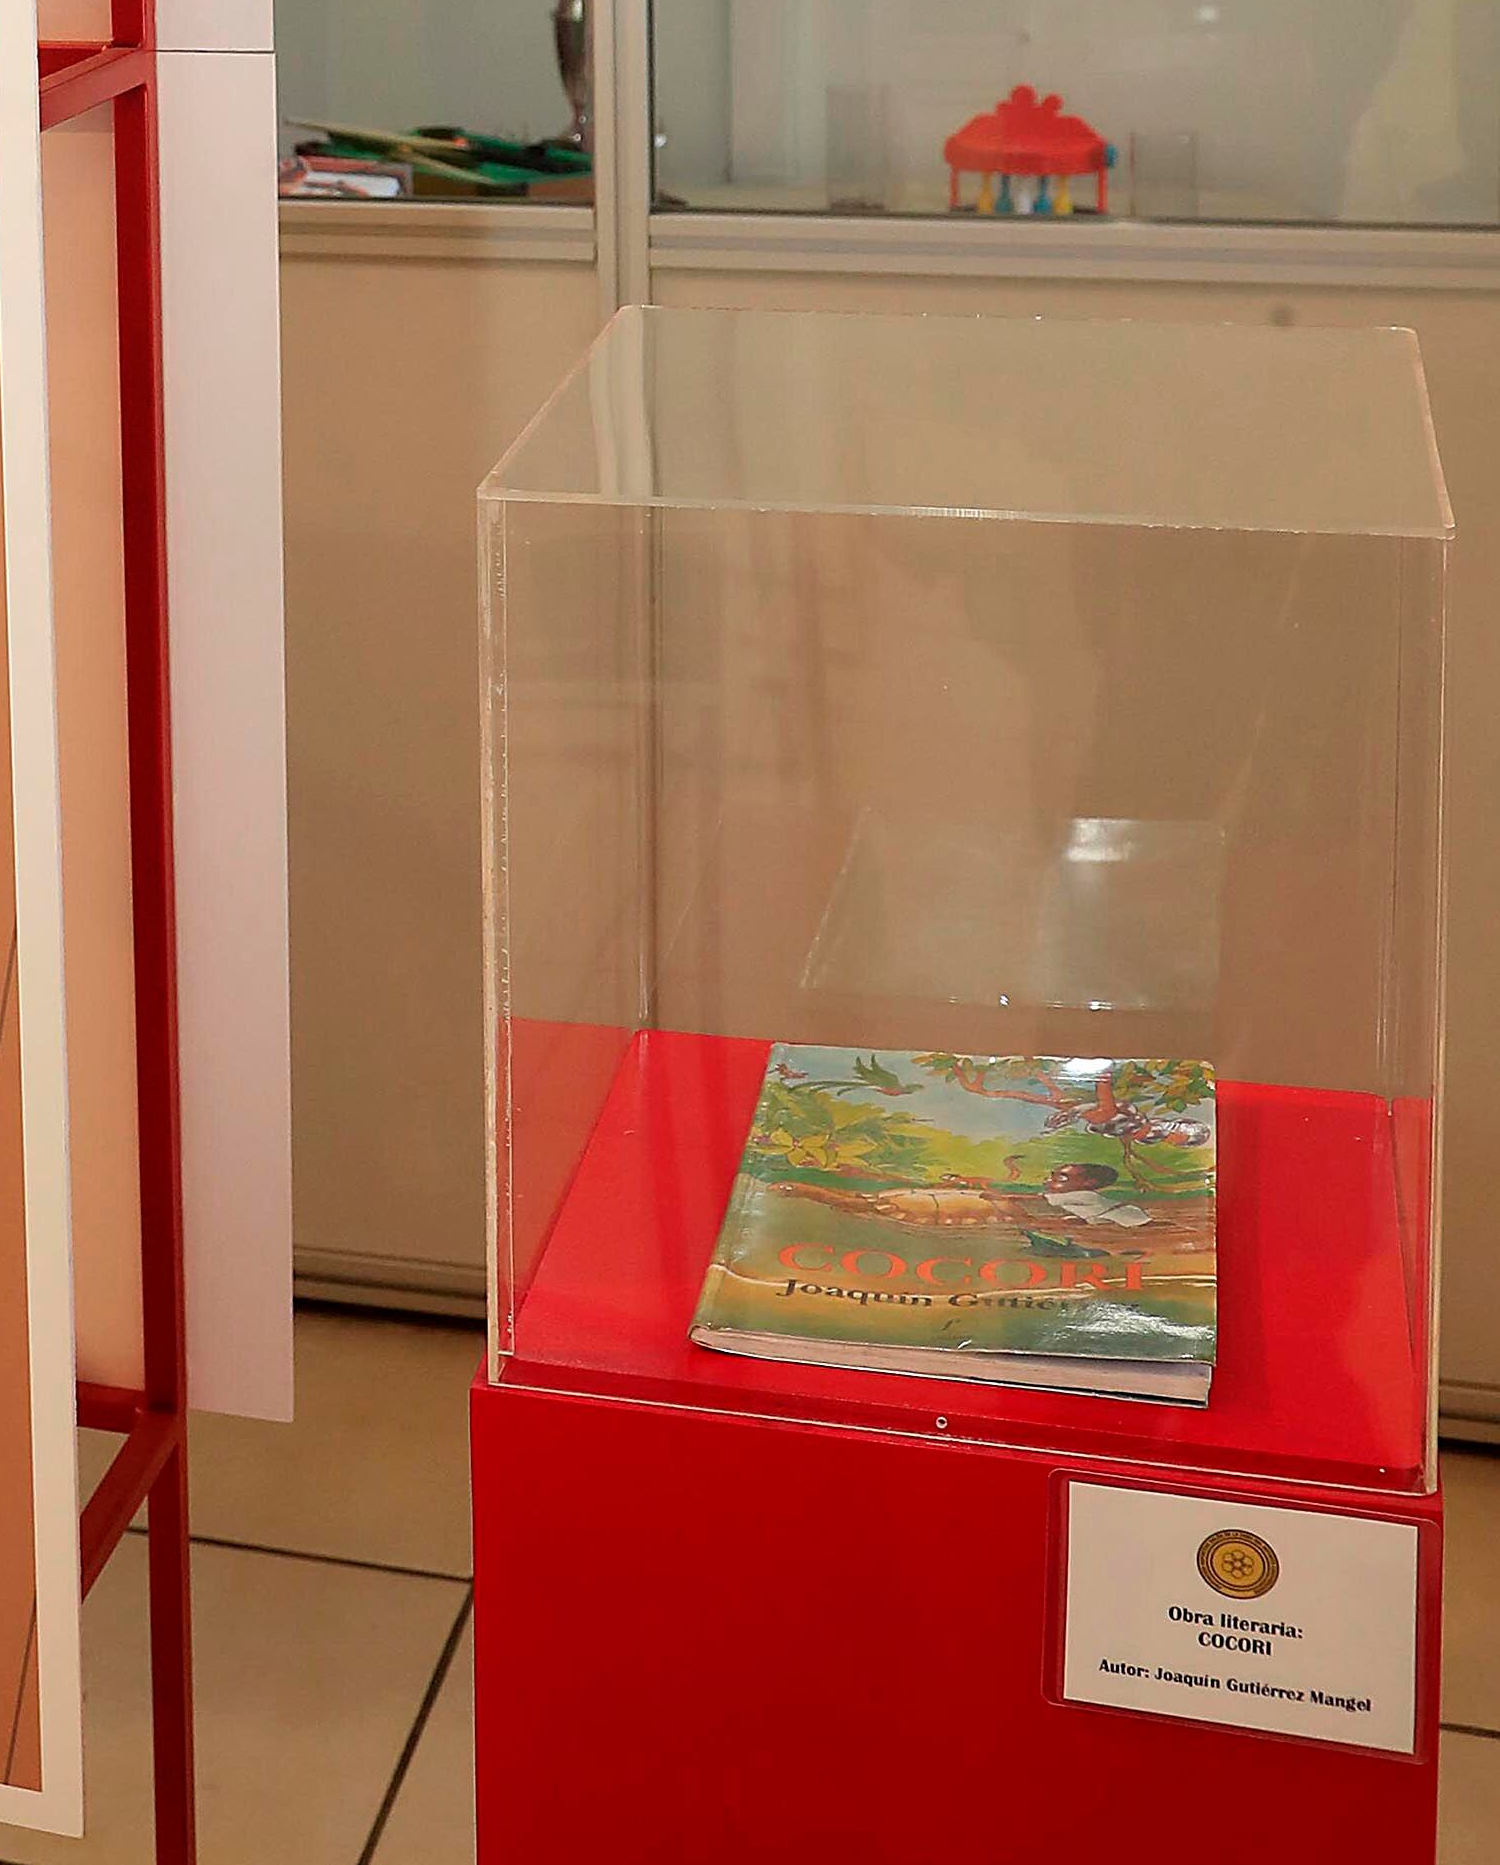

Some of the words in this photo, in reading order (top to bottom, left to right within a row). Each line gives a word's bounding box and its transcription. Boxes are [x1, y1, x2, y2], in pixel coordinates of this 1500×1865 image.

[1168, 1606, 1214, 1627] Obra
[1220, 1613, 1303, 1639] literaria:
[1197, 1631, 1272, 1656] COCORI
[1098, 1658, 1150, 1679] Autor:
[1154, 1667, 1221, 1689] Joaquín
[1226, 1678, 1305, 1702] Gutiérrez
[1310, 1690, 1371, 1713] Mangel
